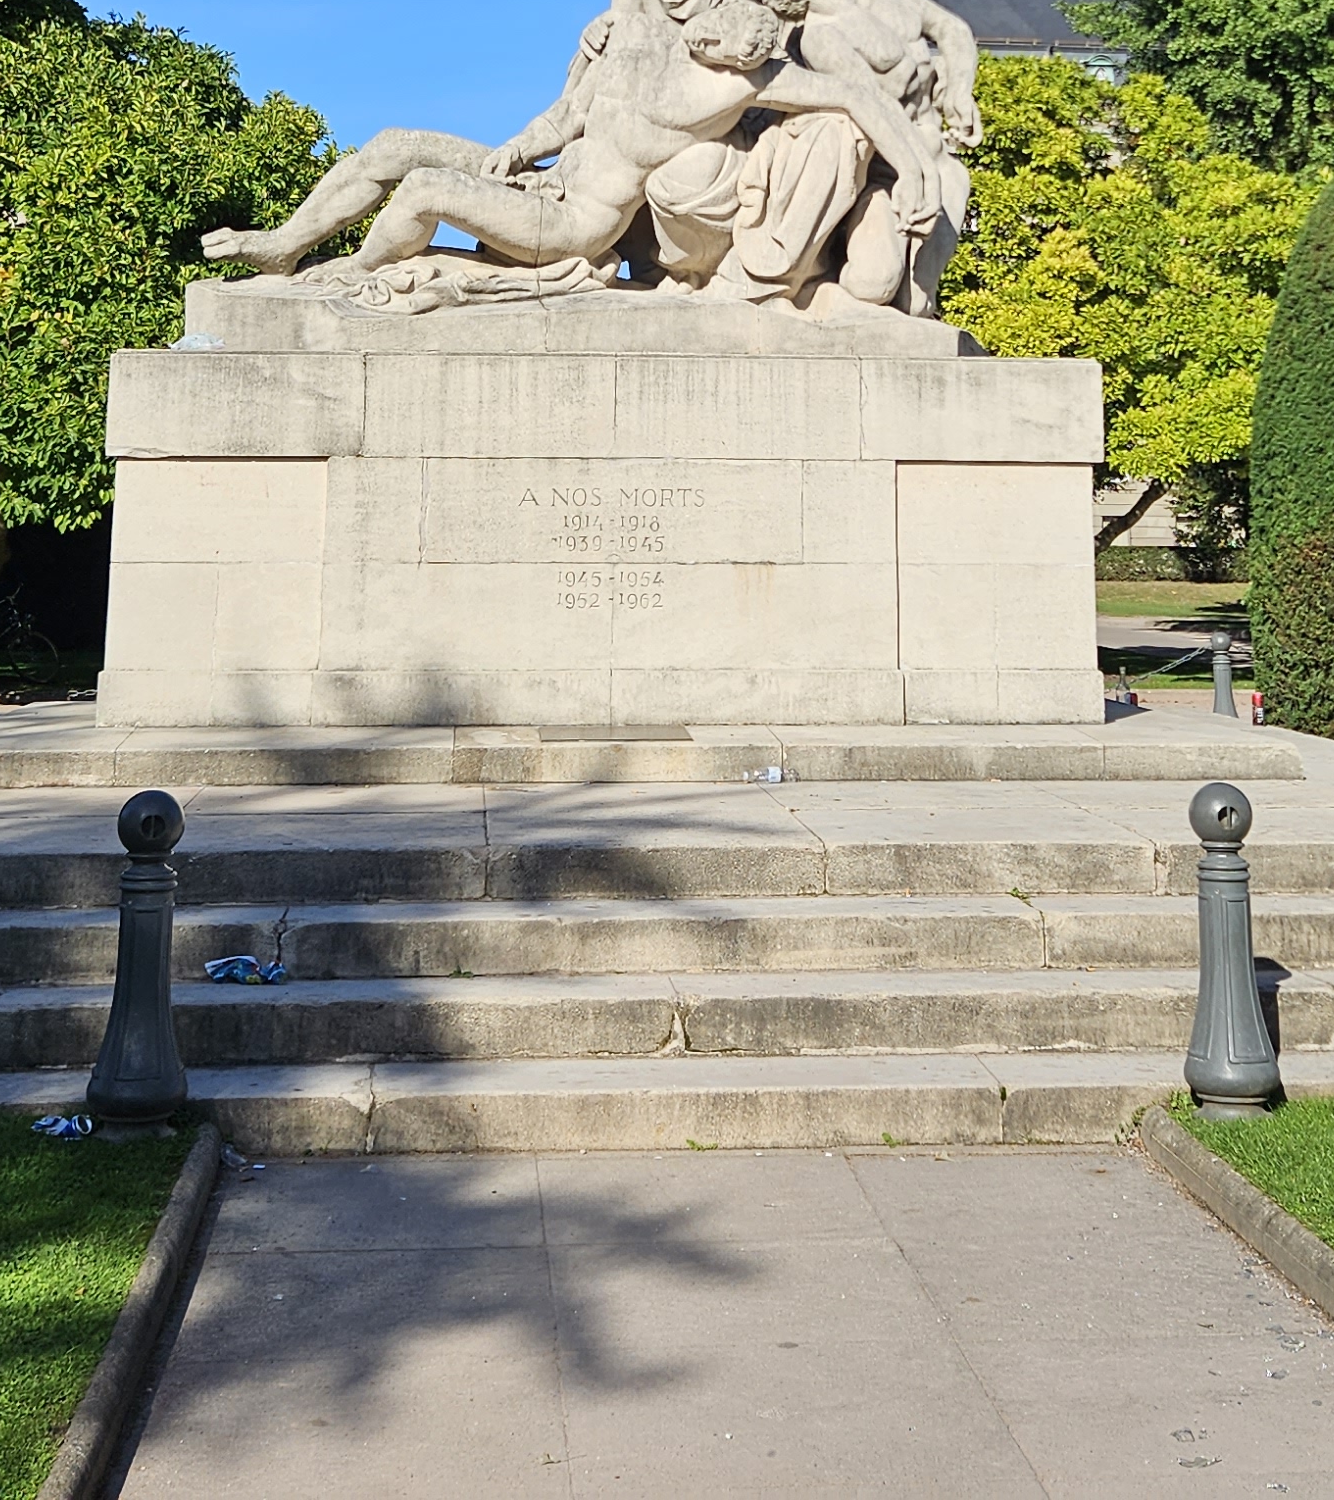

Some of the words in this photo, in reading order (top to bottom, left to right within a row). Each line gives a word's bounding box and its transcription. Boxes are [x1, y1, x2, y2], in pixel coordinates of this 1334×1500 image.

[518, 487, 540, 507] A
[551, 487, 602, 507] NOS
[619, 487, 705, 508] MORTS
